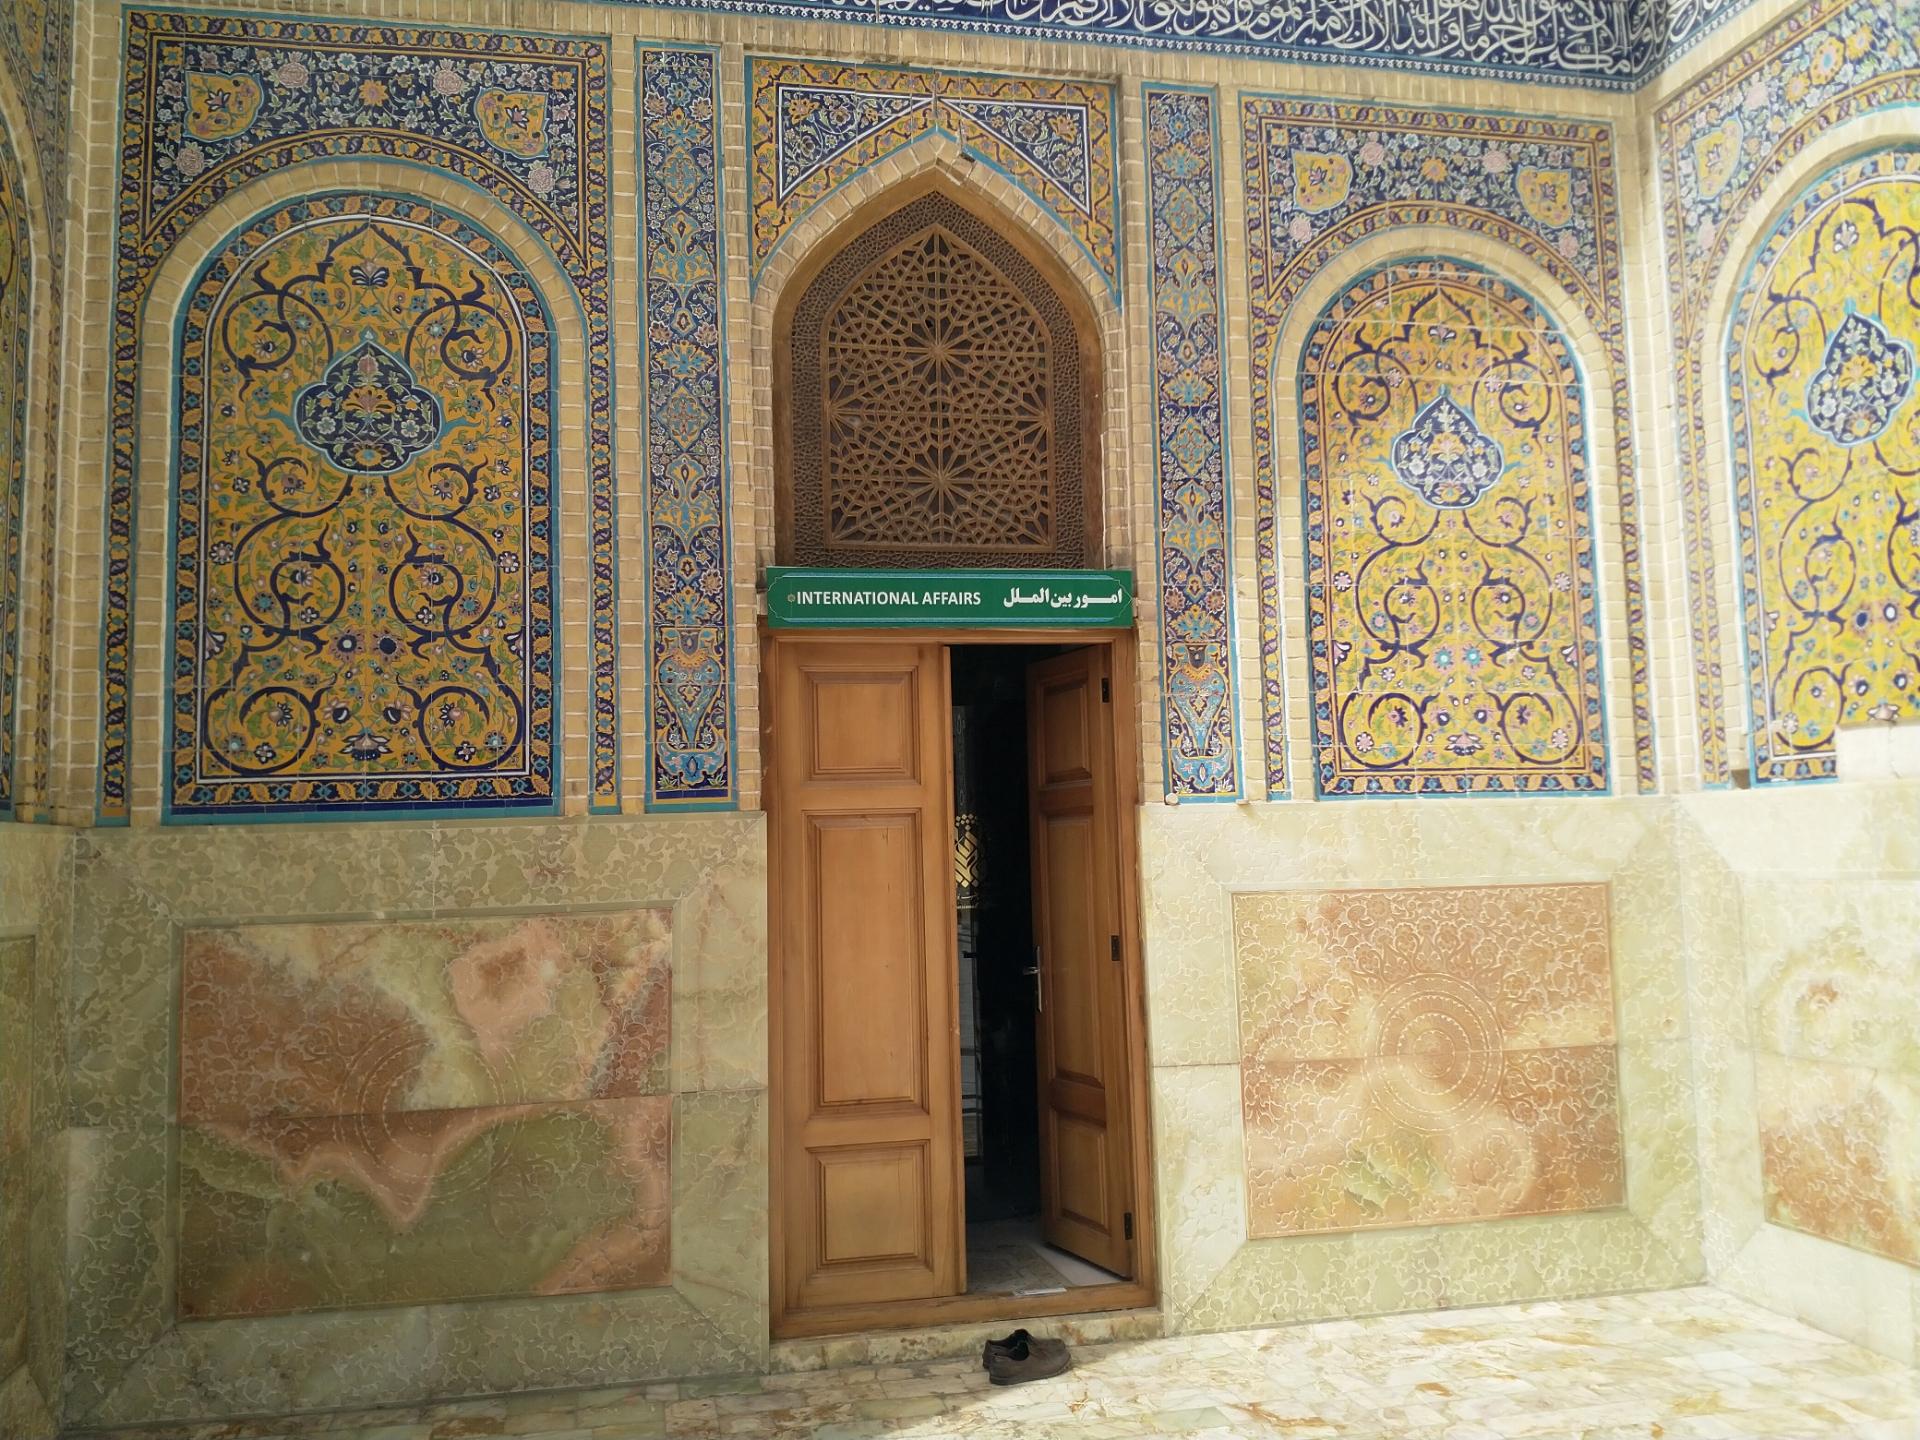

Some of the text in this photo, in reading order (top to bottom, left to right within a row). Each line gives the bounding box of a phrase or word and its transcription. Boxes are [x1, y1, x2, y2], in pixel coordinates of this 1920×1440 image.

[797, 591, 981, 605] INTERNATIONAL AFFAIRS
[1073, 588, 1123, 608] امور
